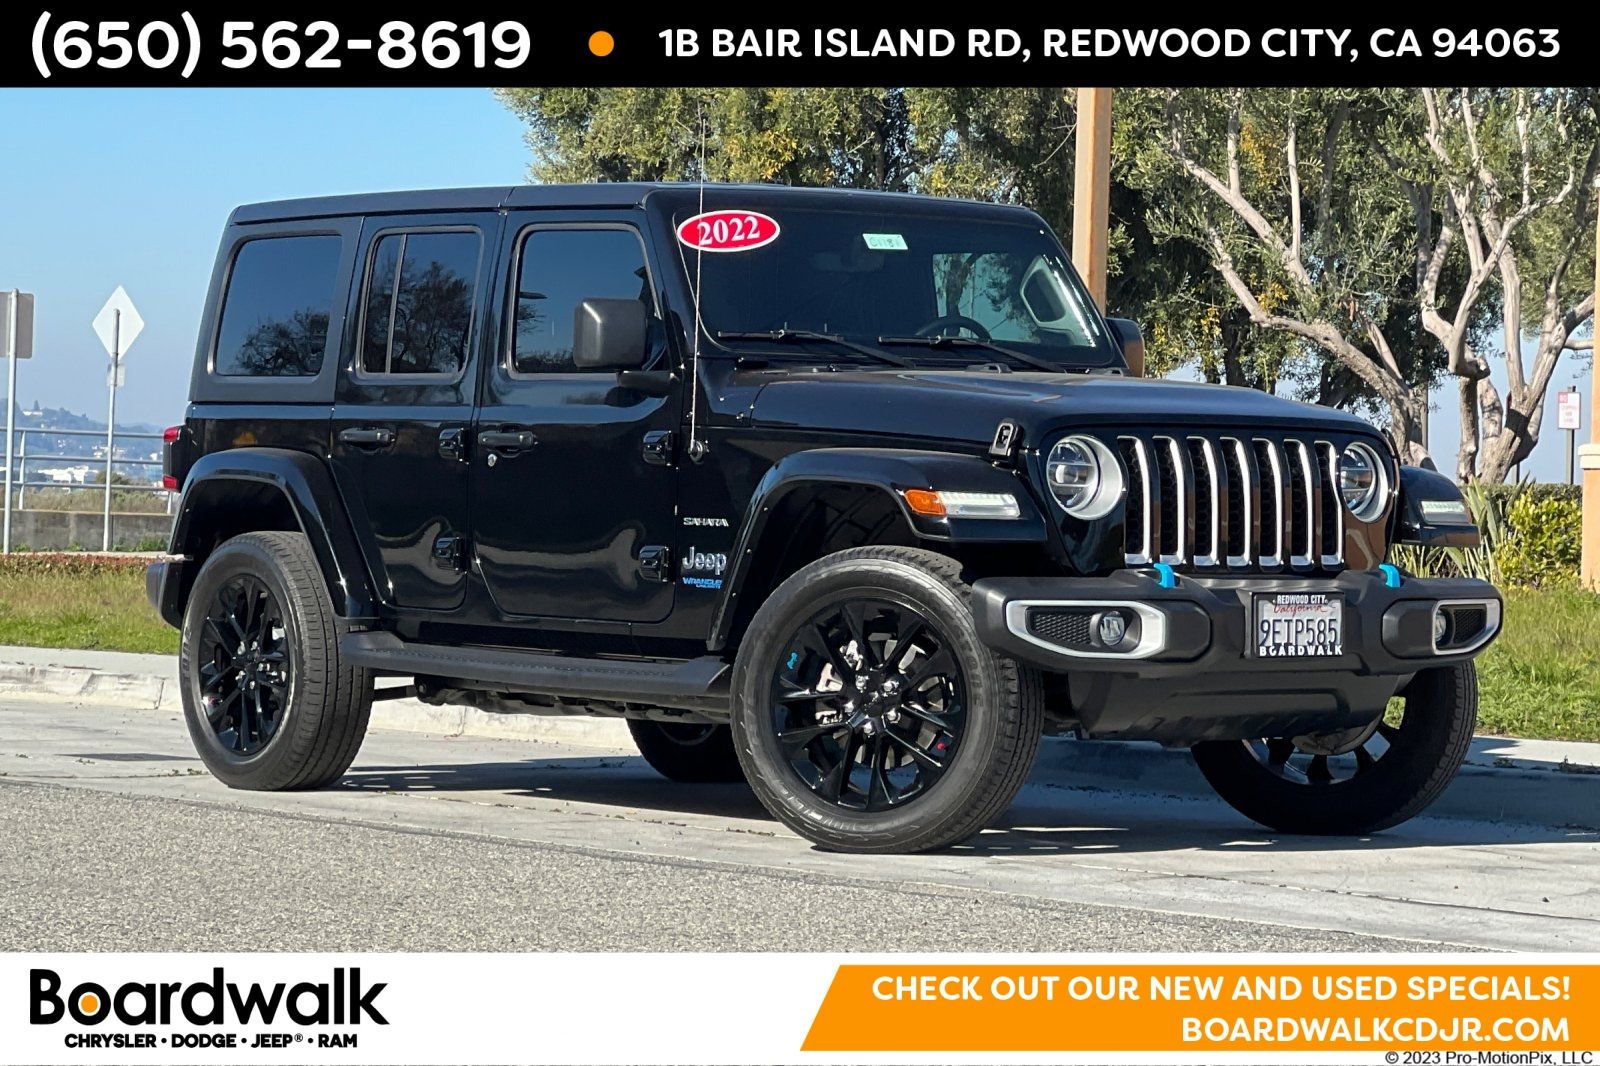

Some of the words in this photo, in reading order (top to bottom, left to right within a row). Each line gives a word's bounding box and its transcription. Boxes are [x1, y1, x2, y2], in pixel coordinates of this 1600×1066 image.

[696, 215, 760, 246] 2022
[683, 517, 729, 527] SAHARA
[682, 546, 727, 575] Jeep
[1277, 594, 1309, 605] REDWOOD
[1310, 594, 1326, 605] CITY
[1259, 618, 1338, 646] 9ETP585
[1259, 645, 1343, 657] BOARDWALK
